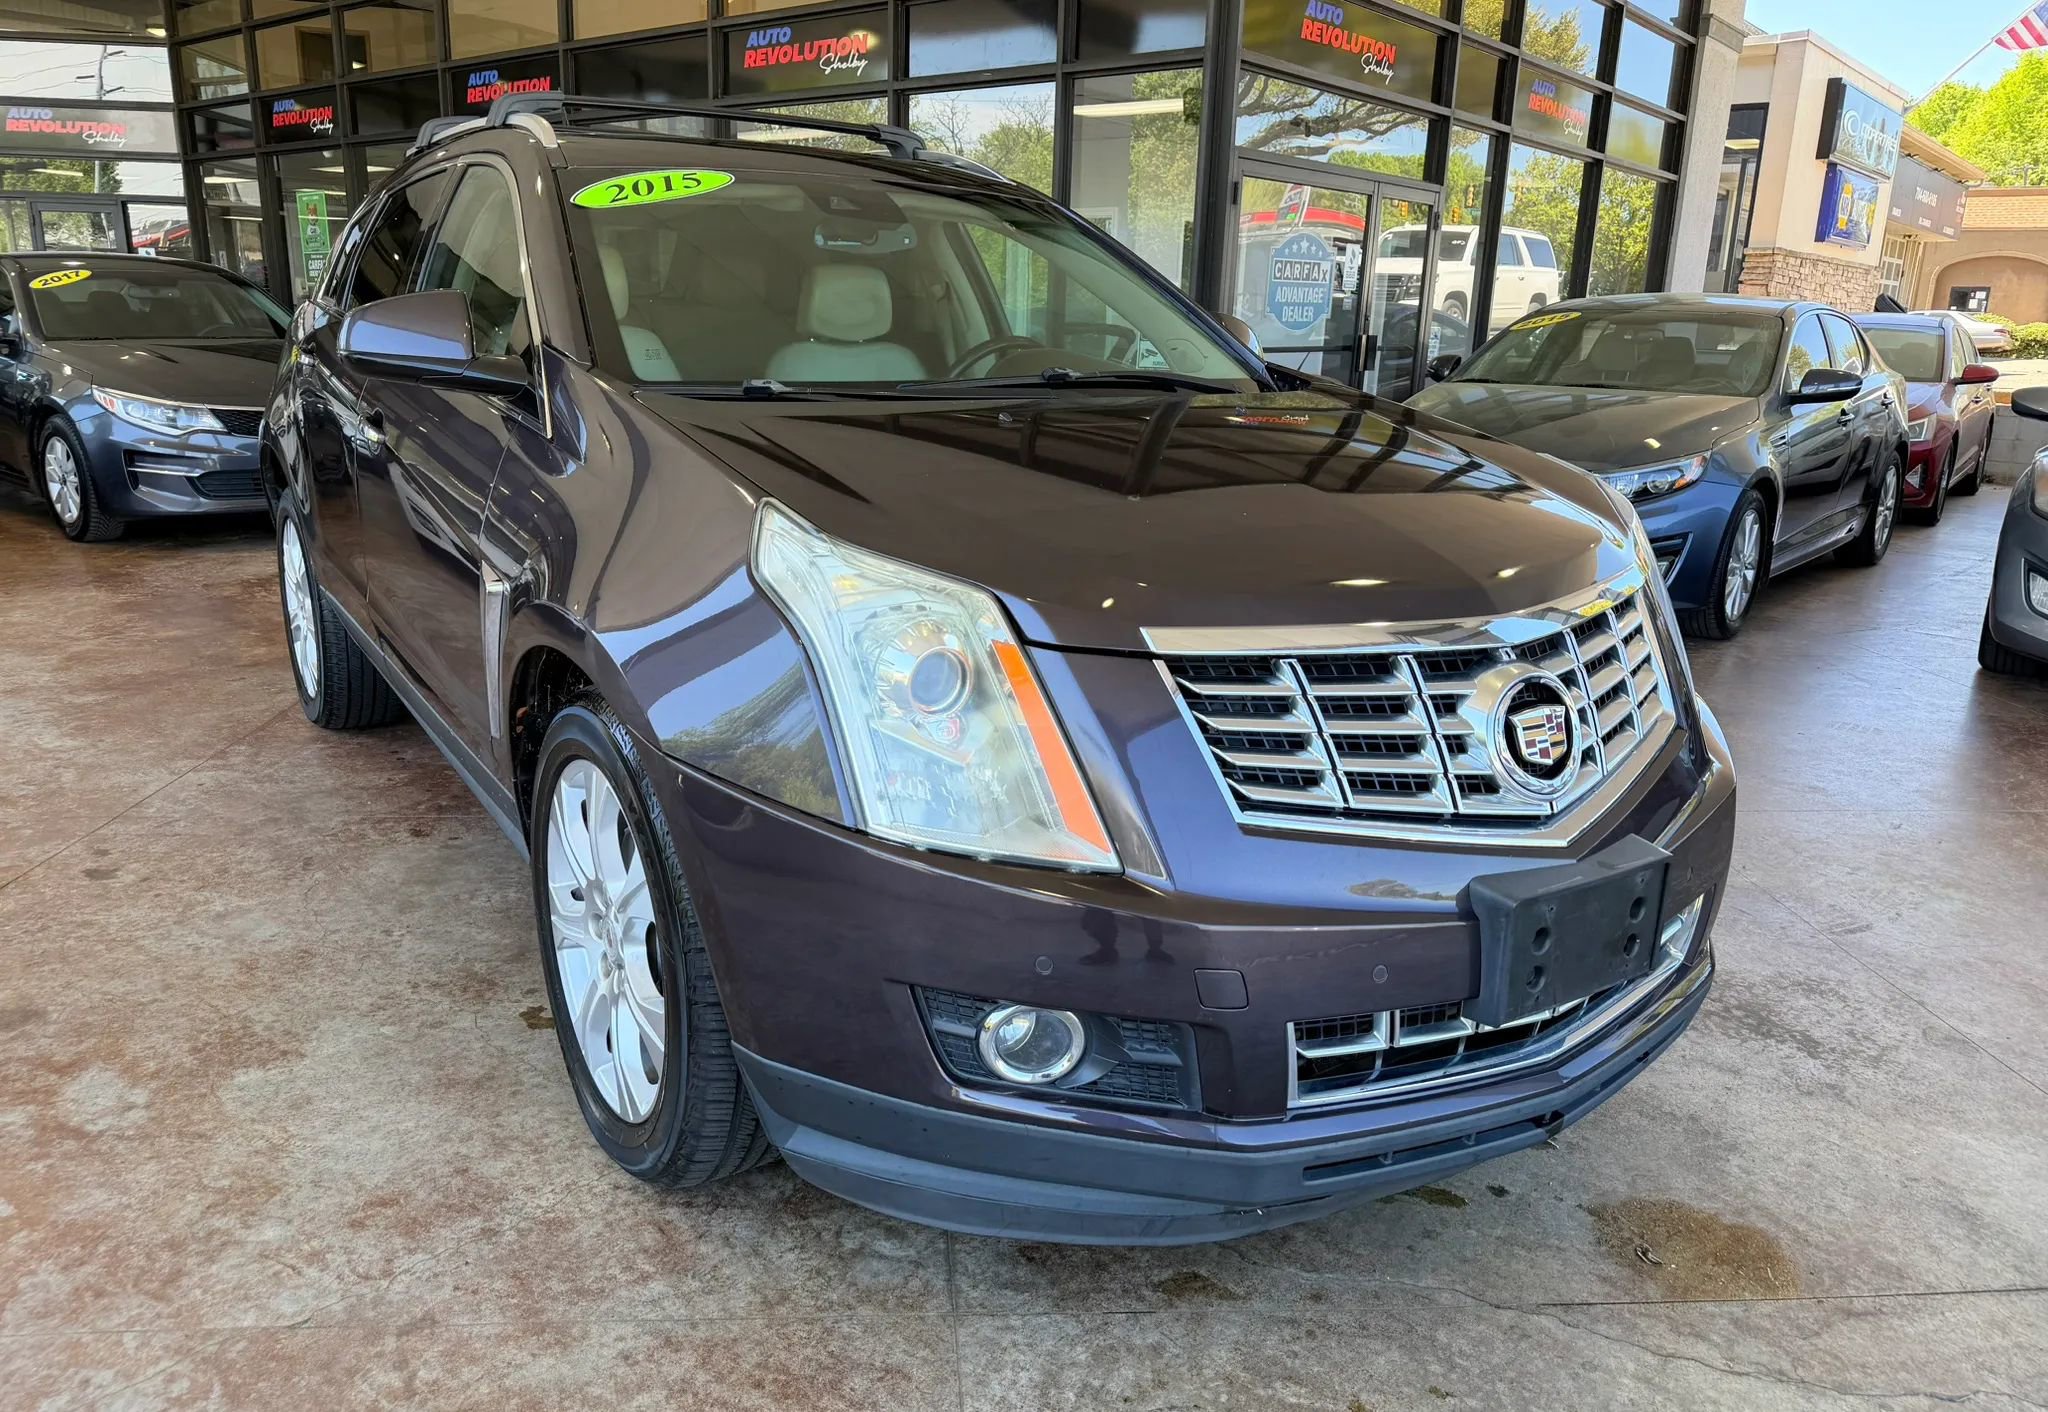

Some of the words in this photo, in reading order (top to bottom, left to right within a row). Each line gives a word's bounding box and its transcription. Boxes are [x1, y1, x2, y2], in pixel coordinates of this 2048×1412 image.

[1304, 0, 1344, 25] AUTO
[746, 26, 791, 48] AUTO
[1300, 18, 1397, 64] REVOLUTION
[743, 33, 869, 68] REVOLUTION
[819, 50, 868, 76] Shelby
[1361, 52, 1395, 85] Shelby
[468, 69, 499, 87] AUTO
[1531, 80, 1556, 98] AUTO
[7, 107, 53, 119] AUTO
[273, 99, 295, 112] AUTO
[1528, 93, 1586, 126] REVOLUTION
[5, 118, 128, 135] REVOLUTION
[272, 106, 333, 128] REVOLUTION
[309, 116, 334, 135] Shelby
[82, 130, 128, 148] Shelby
[606, 172, 702, 203] 2015
[38, 270, 81, 287] 2017
[1274, 261, 1329, 283] CARFAX
[1275, 286, 1323, 303] ADVANTAGE
[1282, 304, 1314, 322] DEALER
